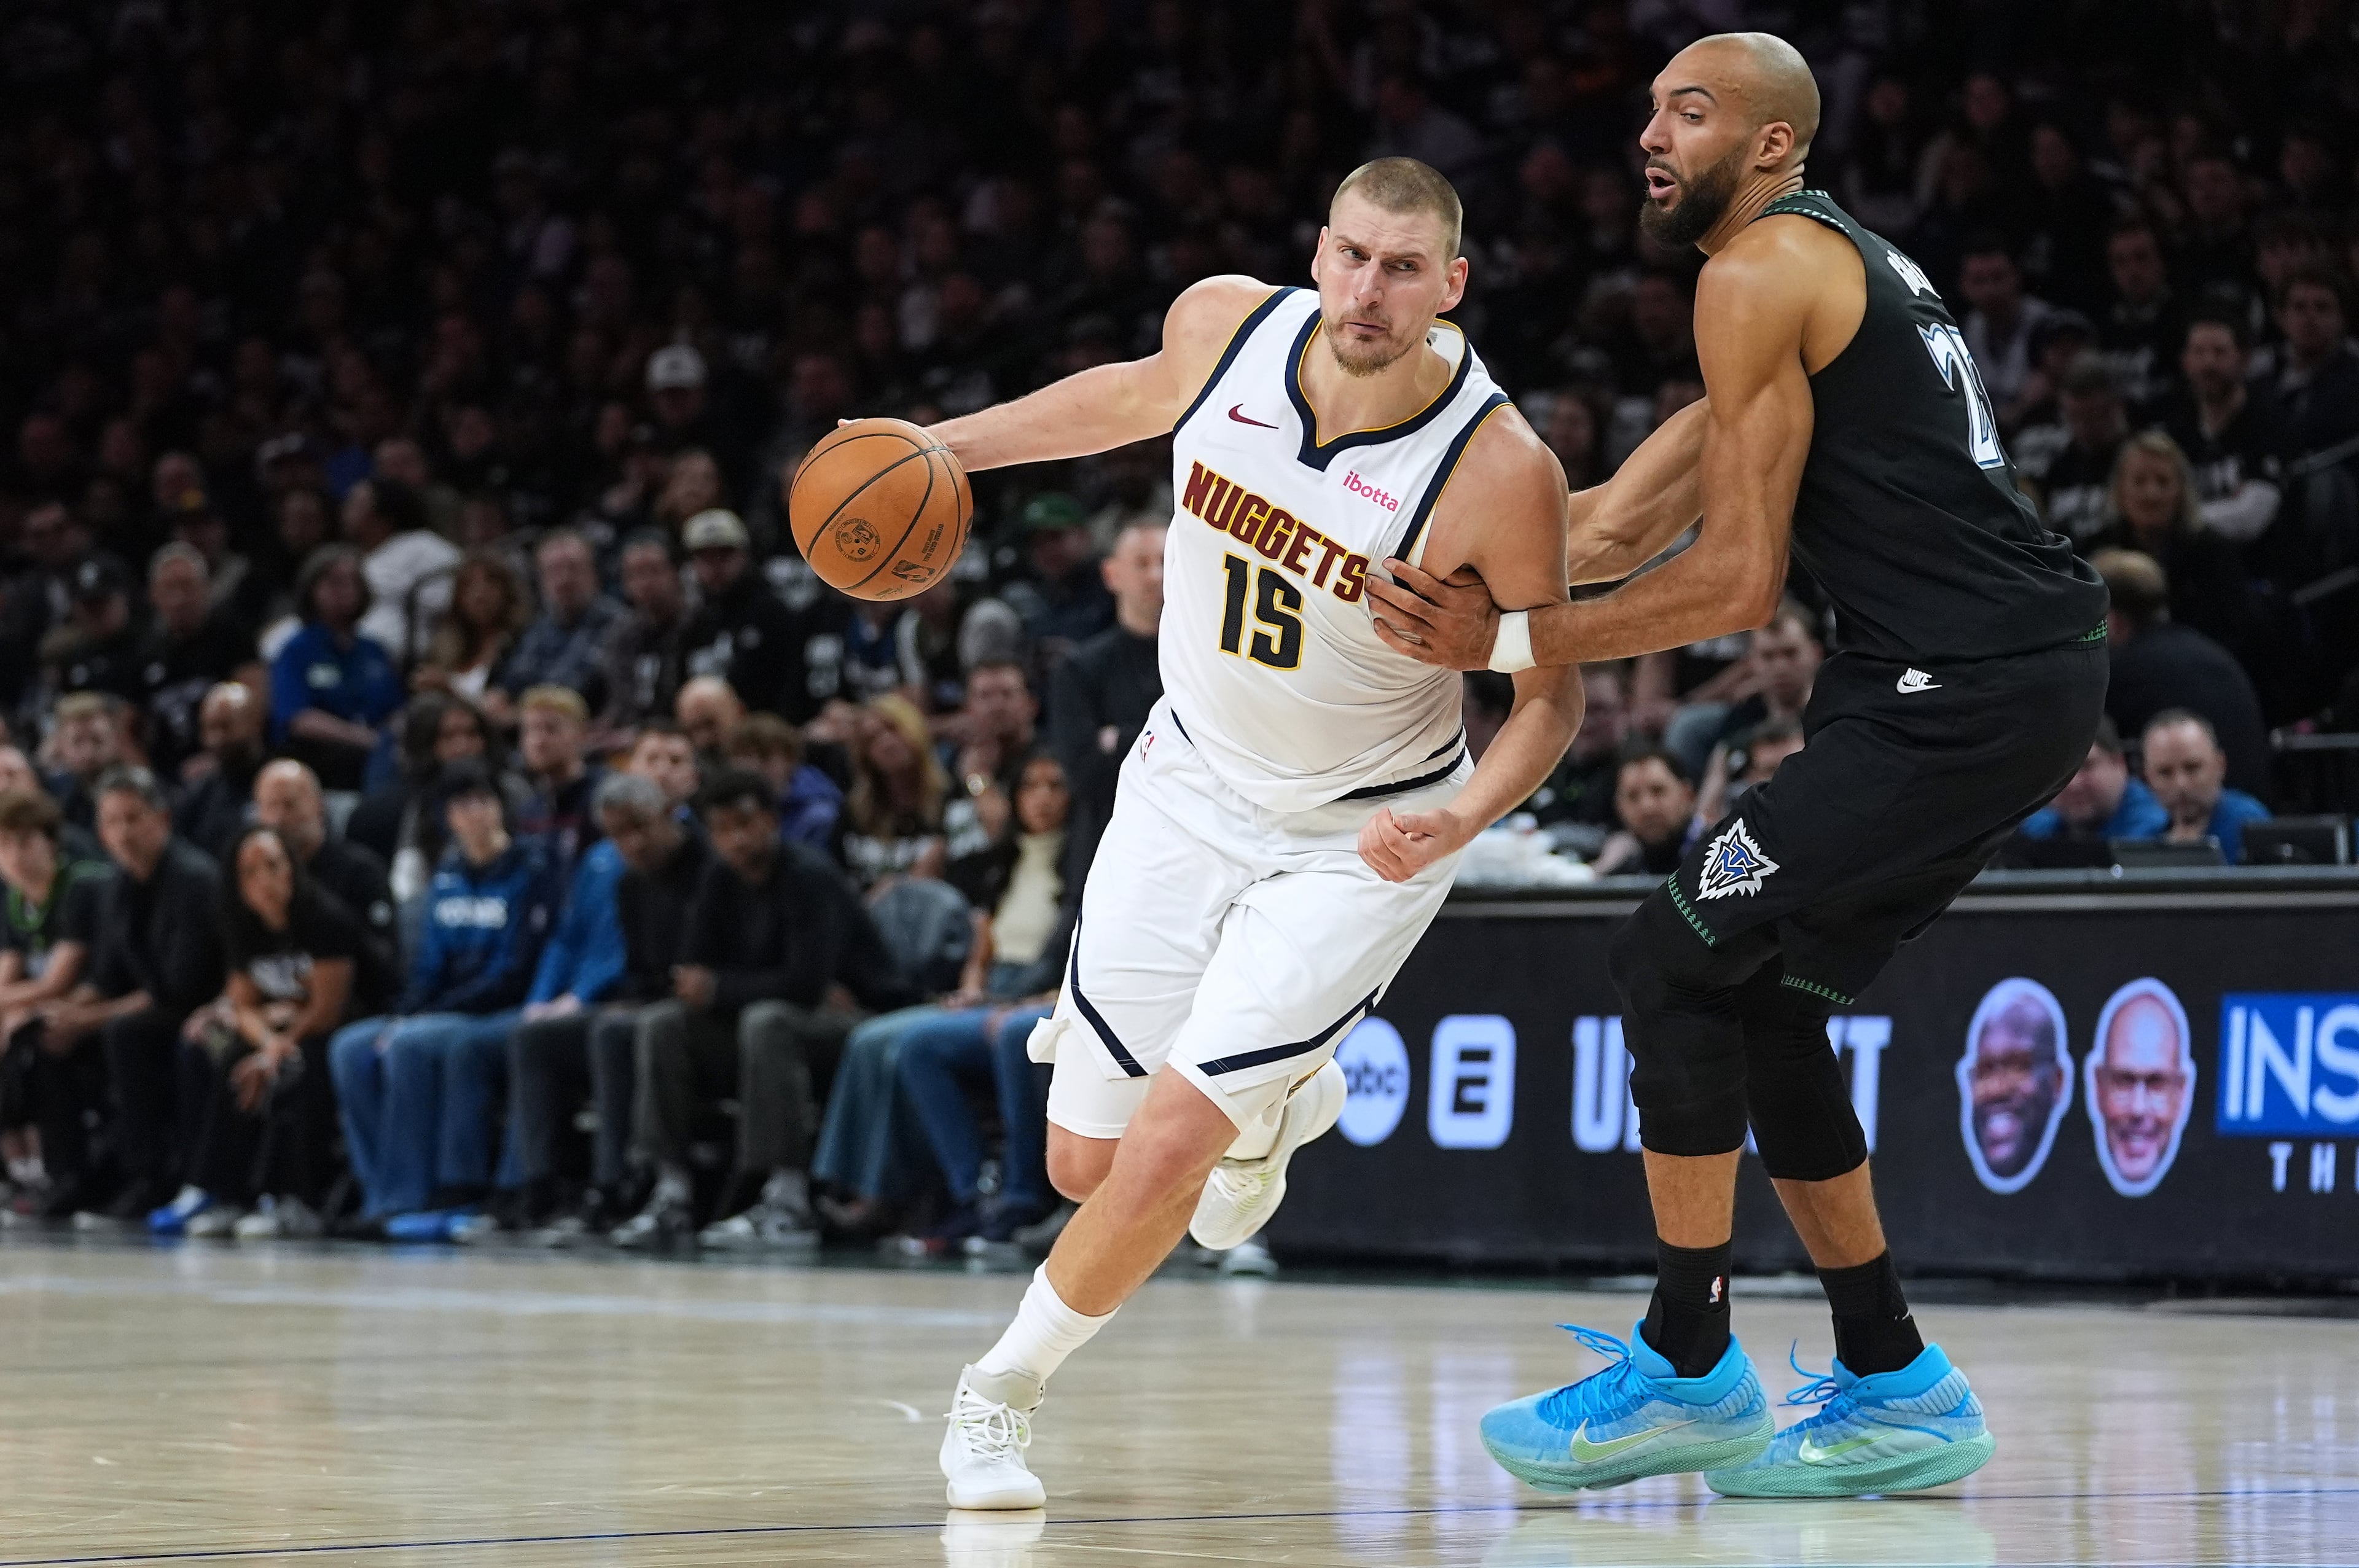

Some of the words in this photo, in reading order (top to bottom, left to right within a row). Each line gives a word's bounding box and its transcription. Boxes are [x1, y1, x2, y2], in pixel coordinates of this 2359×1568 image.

[1342, 470, 1399, 512] ibotta
[1182, 459, 1371, 604] NUGGETS
[1218, 550, 1305, 671] 15
[1903, 667, 1933, 687] NIKE
[1345, 1061, 1397, 1096] abc
[2269, 1141, 2359, 1194] TH
